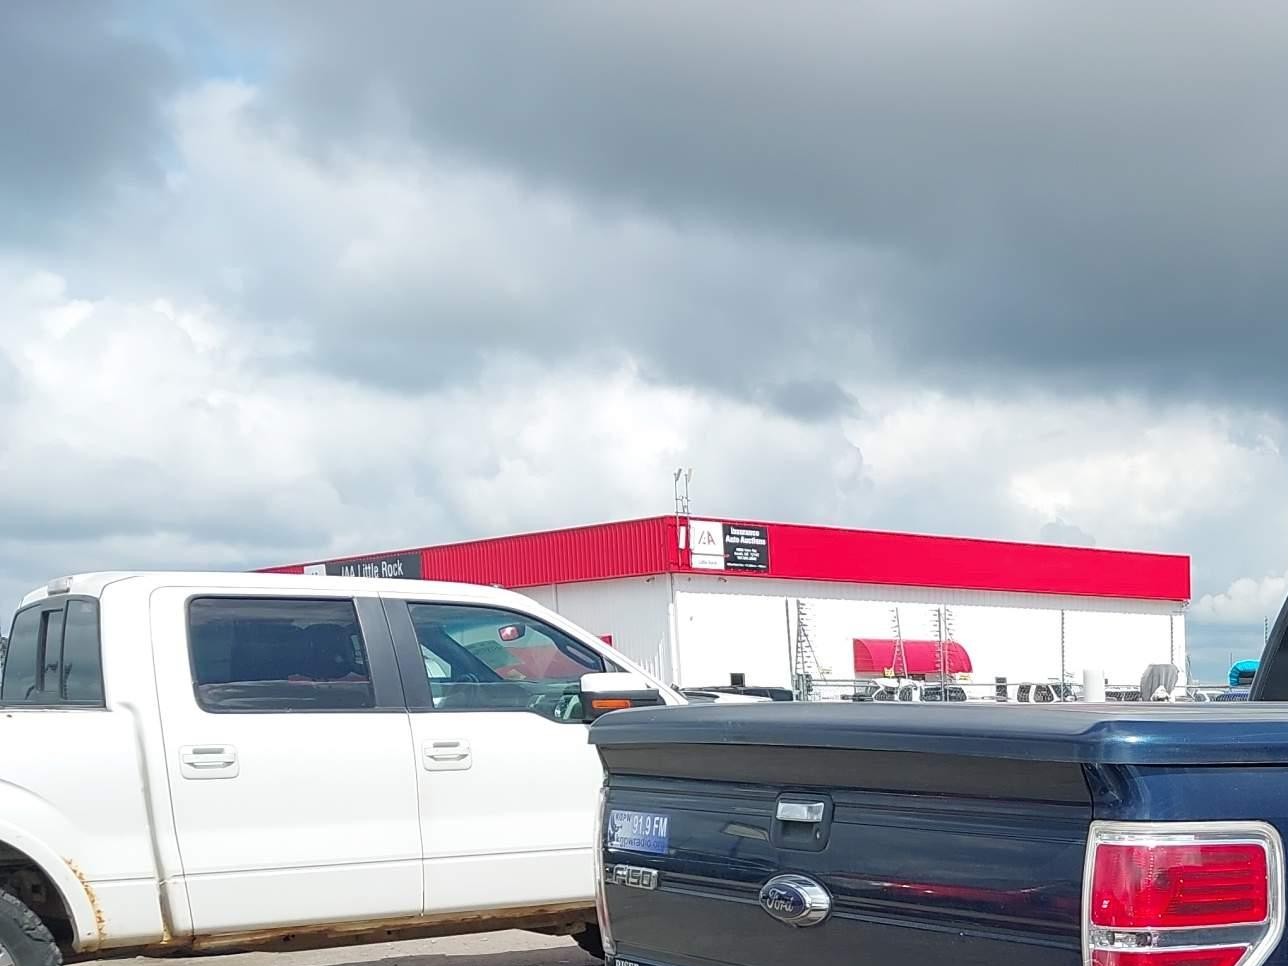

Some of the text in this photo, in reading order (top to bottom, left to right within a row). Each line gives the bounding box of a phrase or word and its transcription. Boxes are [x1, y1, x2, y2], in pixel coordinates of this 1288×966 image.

[381, 560, 404, 577] Rock
[632, 815, 668, 838] 91.9 FM
[766, 887, 794, 912] Ford
